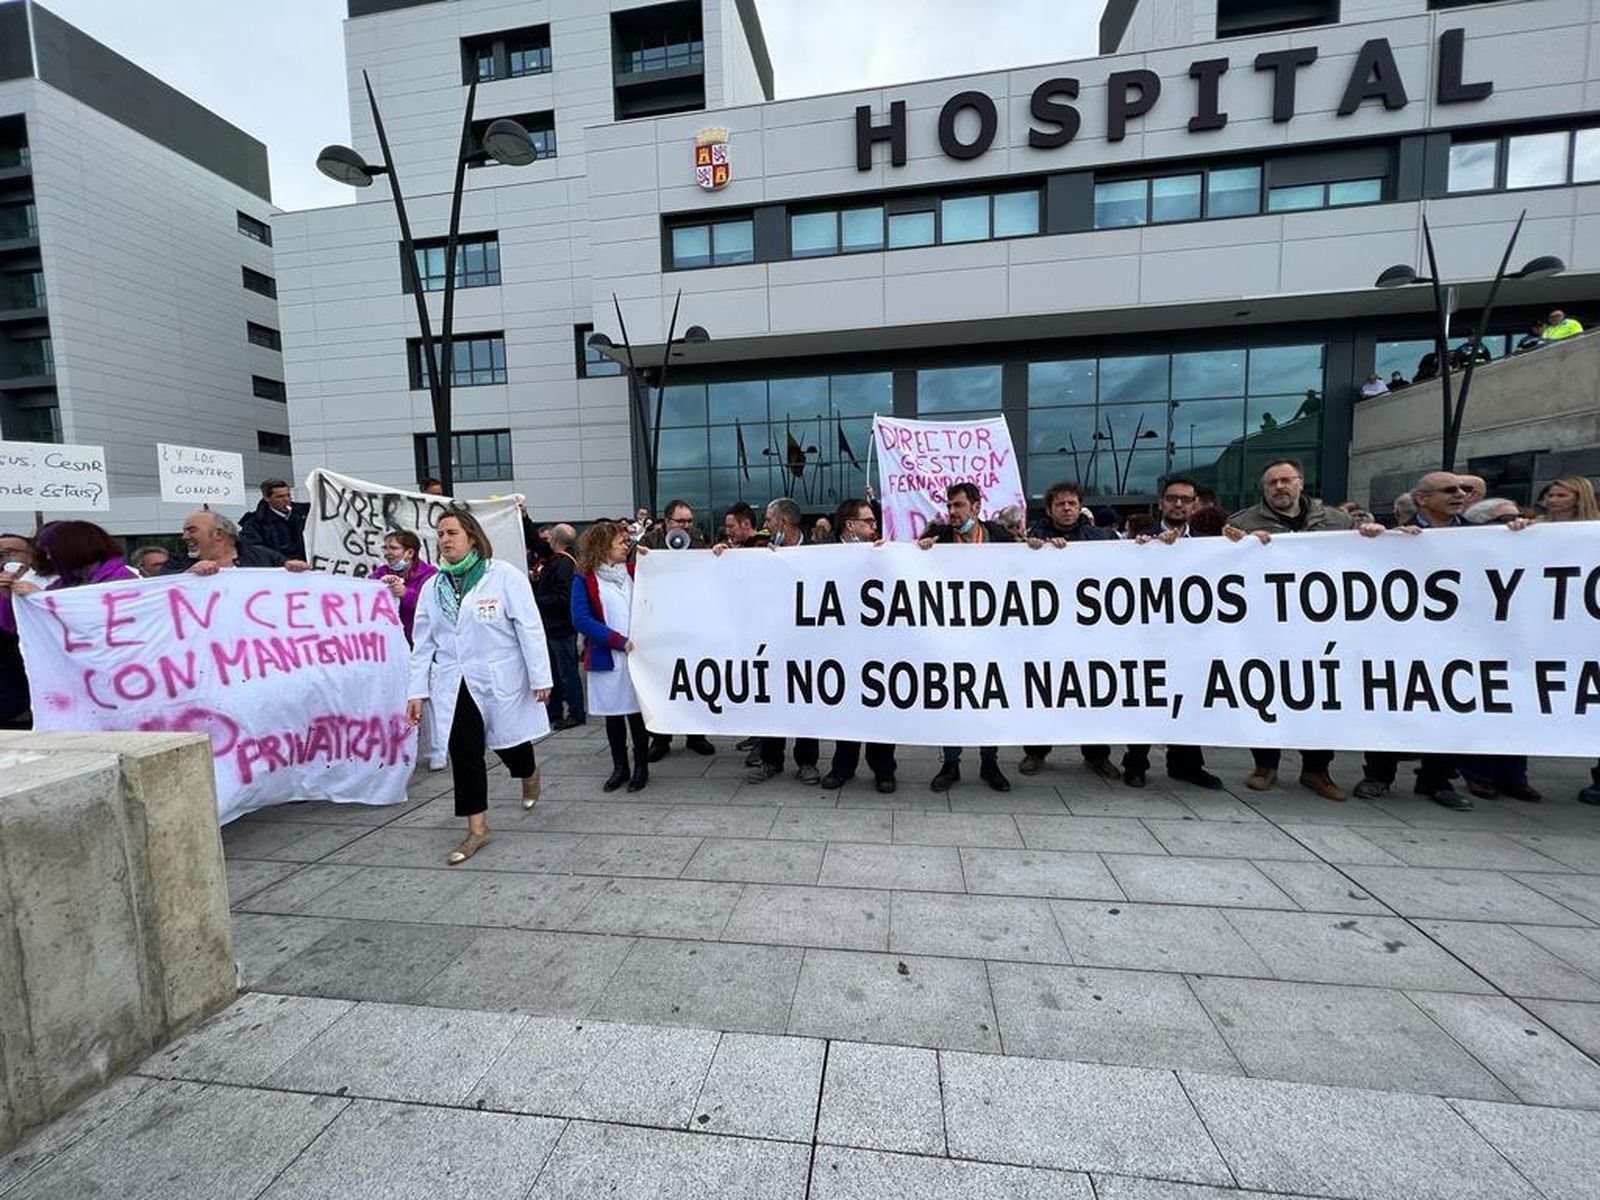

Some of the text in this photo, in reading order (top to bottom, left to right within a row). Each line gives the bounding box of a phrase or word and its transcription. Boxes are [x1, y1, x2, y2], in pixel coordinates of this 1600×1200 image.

[855, 28, 1494, 173] HOSPITAL
[194, 451, 214, 463] LOS
[878, 424, 992, 453] DIRECTOR
[901, 450, 1009, 474] GESTION
[795, 579, 846, 627] LA
[860, 578, 1060, 627] SANIDAD
[1076, 574, 1248, 626] SOMOS
[1264, 569, 1461, 623] TODOS
[1485, 568, 1525, 622] Y
[84, 651, 196, 709] CON
[669, 643, 771, 715] AQUÍ
[786, 658, 846, 706] NO
[861, 660, 1010, 710] SOBRA
[1024, 659, 1184, 719] NADIE,
[1203, 641, 1342, 724] AQUÍ
[1362, 659, 1513, 714] HACE
